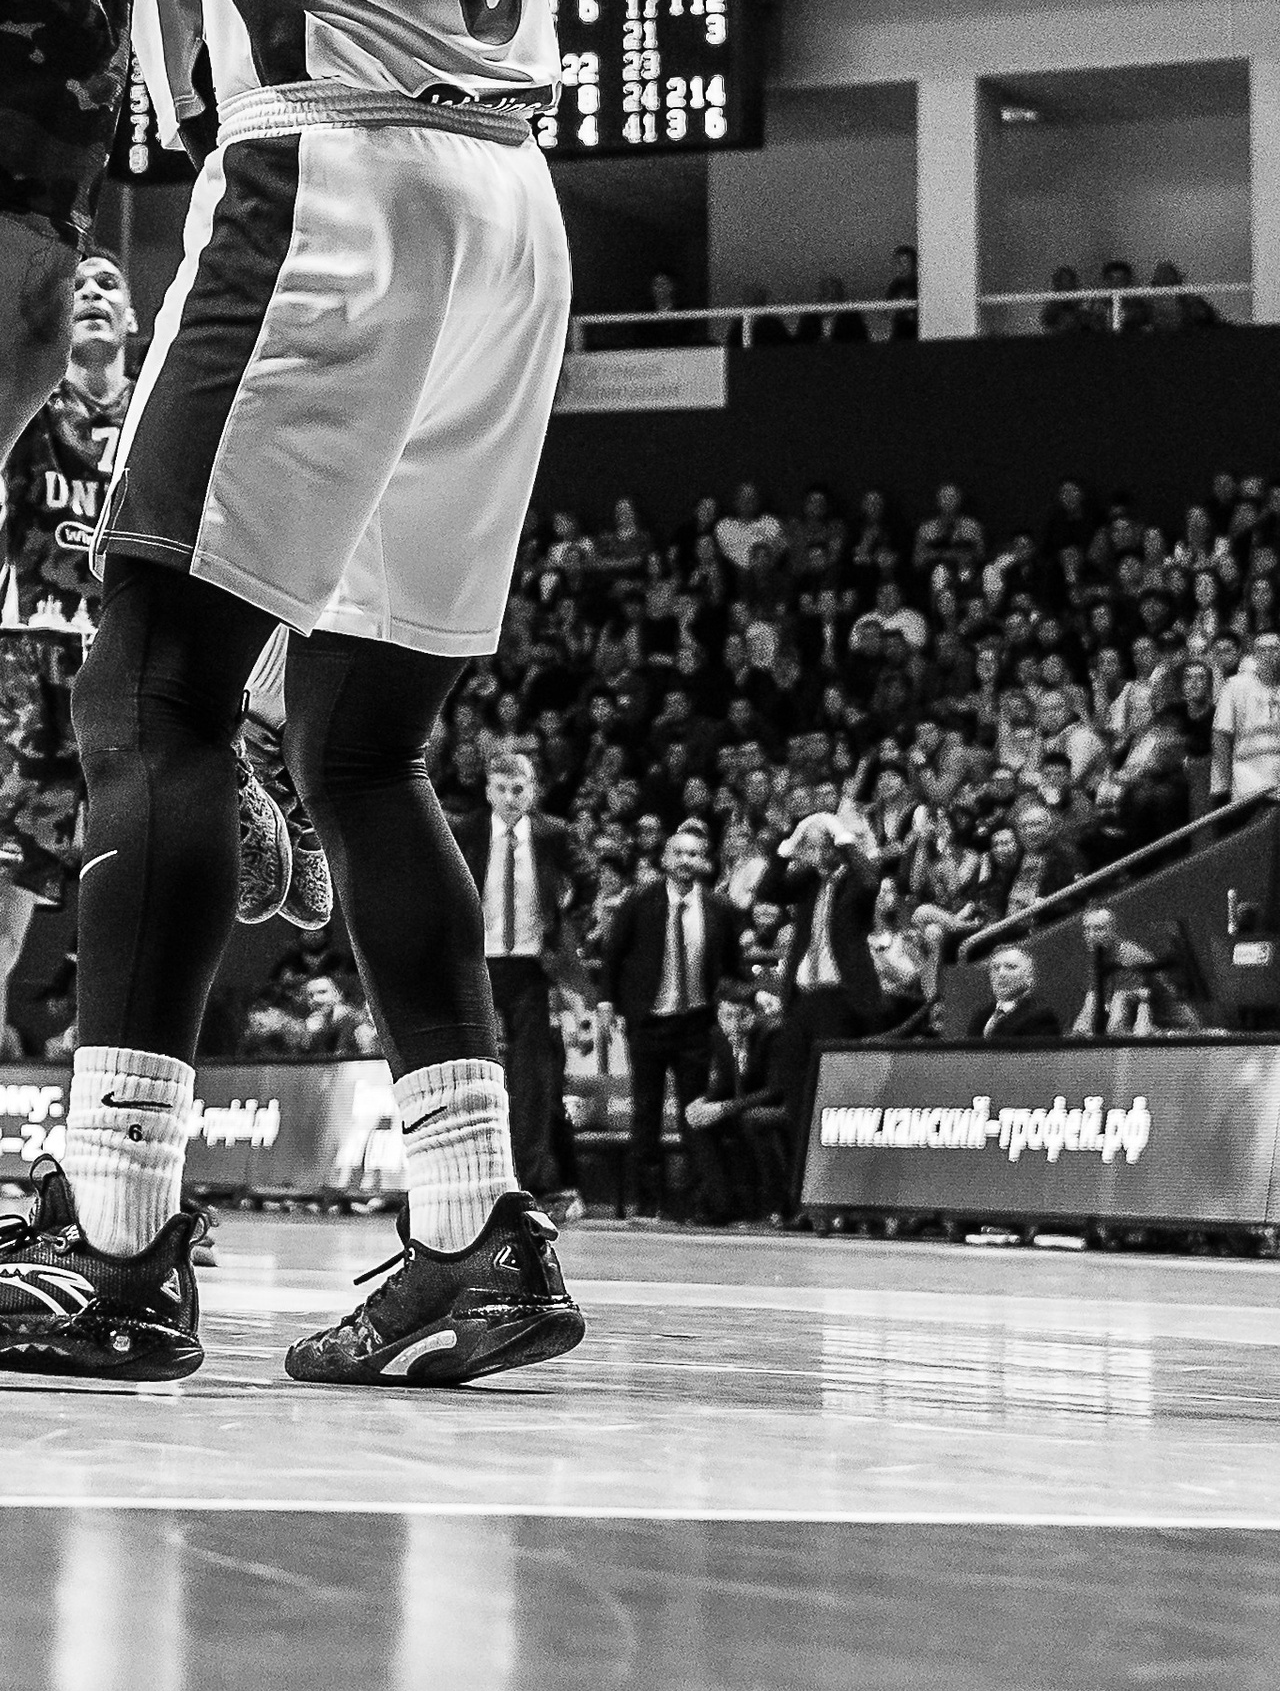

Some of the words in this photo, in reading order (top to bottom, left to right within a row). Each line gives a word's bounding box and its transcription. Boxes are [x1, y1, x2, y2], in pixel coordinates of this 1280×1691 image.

[622, 19, 659, 51] 21
[705, 12, 727, 45] 3
[622, 49, 661, 81] 23
[622, 81, 661, 113] 24
[128, 1123, 143, 1142] 6
[821, 1095, 1151, 1165] www.камский-трофей.рф
